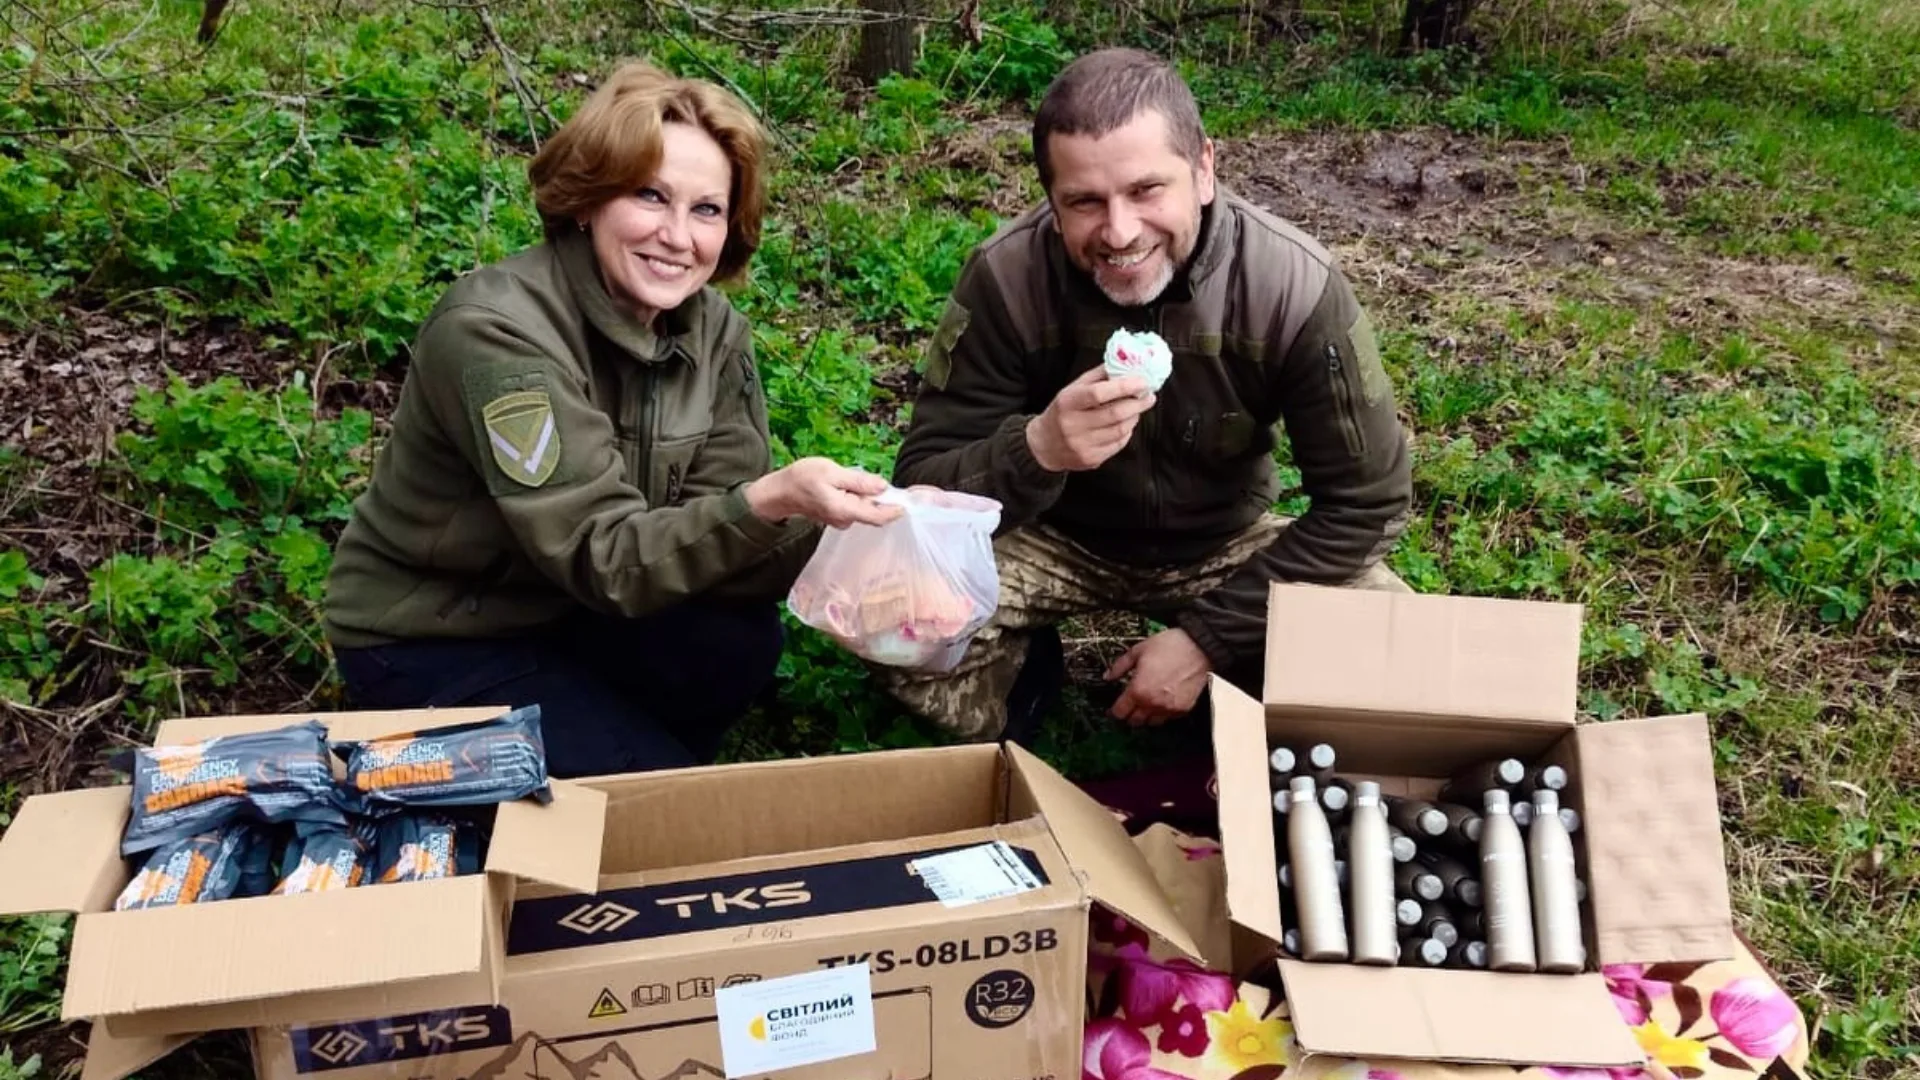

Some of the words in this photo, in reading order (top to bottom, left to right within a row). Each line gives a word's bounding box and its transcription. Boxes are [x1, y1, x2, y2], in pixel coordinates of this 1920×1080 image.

[151, 759, 239, 785] EMGENCY
[655, 881, 812, 919] TKS
[975, 977, 1027, 1004] R32
[766, 993, 854, 1022] СВІТЛИЙ
[378, 1014, 492, 1051] TKS
[770, 1028, 808, 1042] ФОНД
